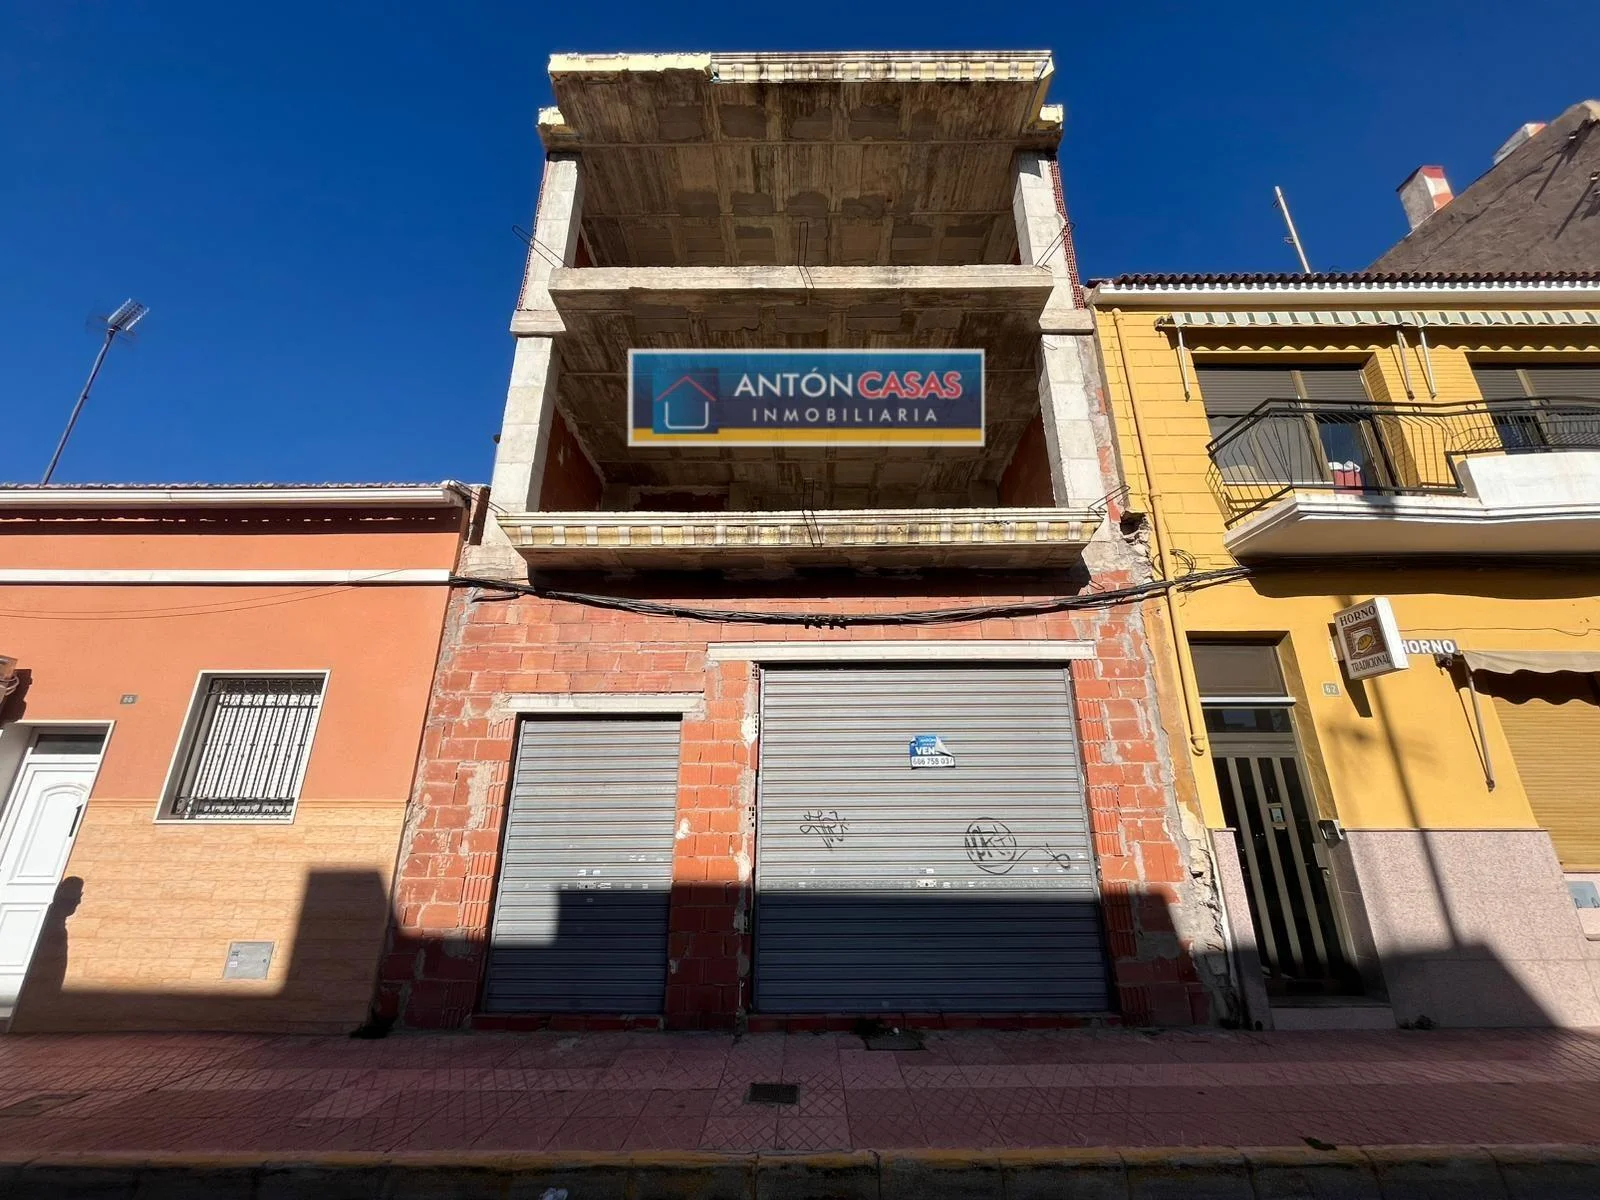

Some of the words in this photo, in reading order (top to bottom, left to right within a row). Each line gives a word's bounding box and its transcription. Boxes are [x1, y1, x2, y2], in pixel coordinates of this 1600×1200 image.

[1339, 605, 1376, 627] HORNO
[1351, 653, 1392, 673] TRADICIONAL
[915, 746, 940, 755] VEN
